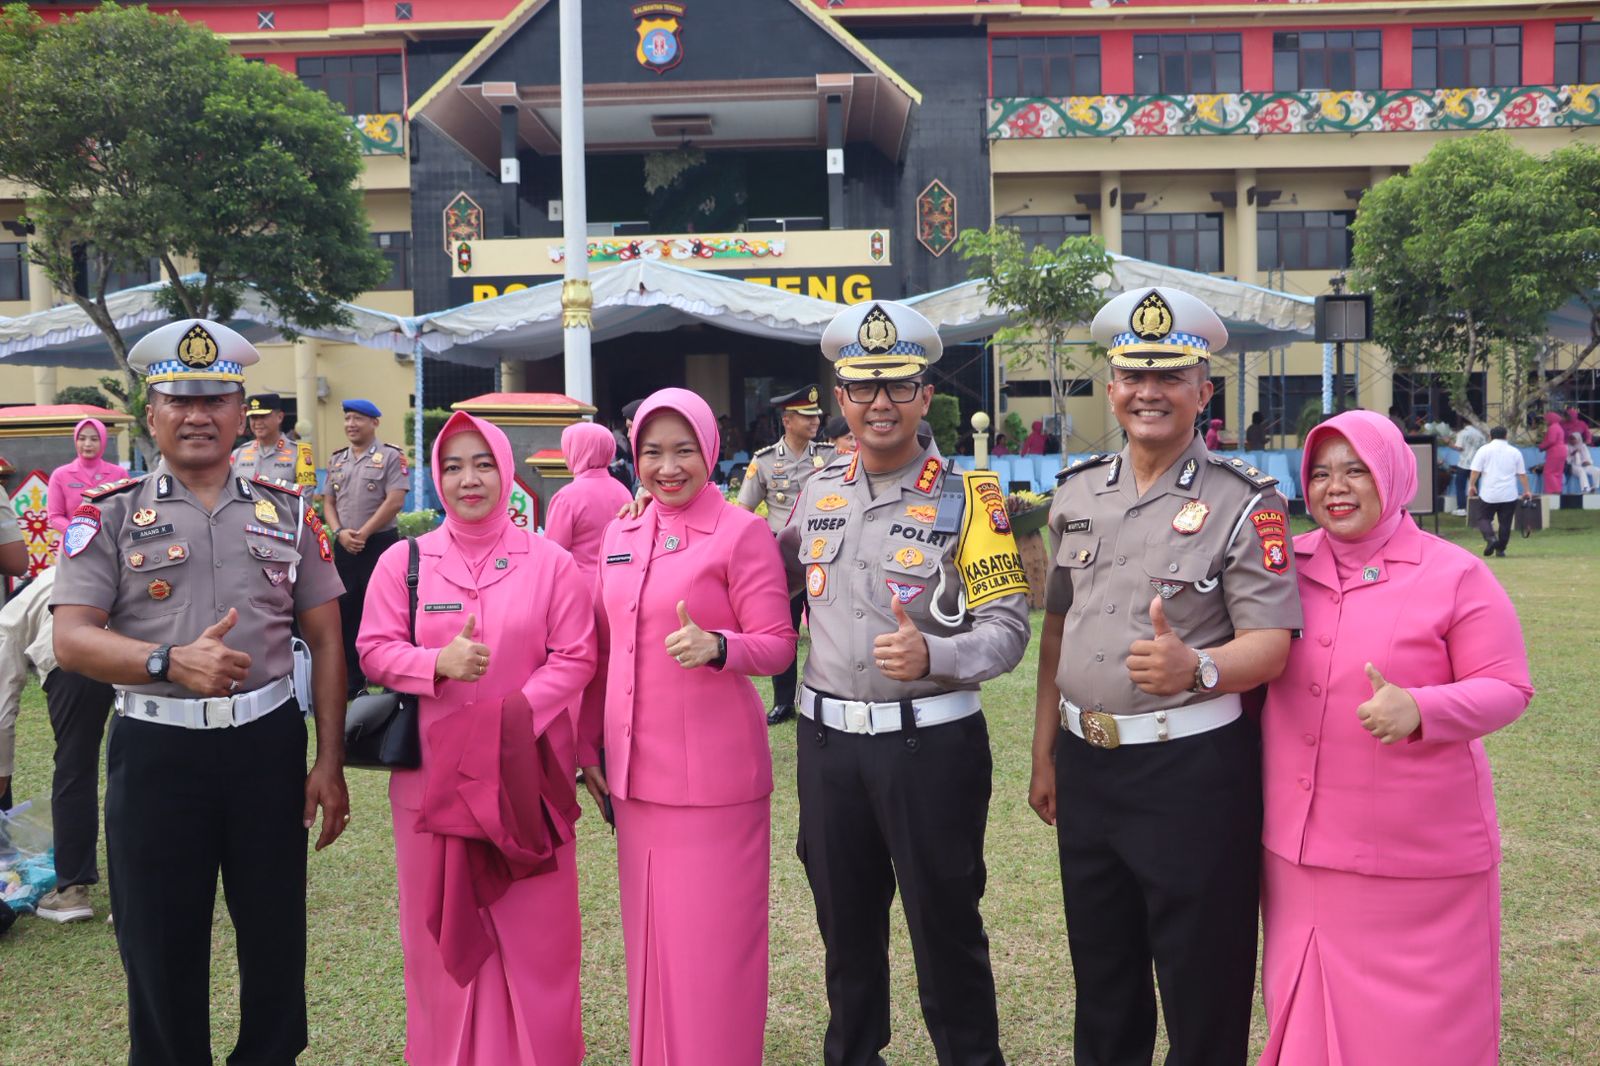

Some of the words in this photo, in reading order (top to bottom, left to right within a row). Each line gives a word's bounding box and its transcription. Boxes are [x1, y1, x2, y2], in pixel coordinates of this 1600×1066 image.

[1254, 513, 1282, 523] POLDA
[140, 528, 160, 538] ANANG
[807, 517, 846, 531] YUSEP
[889, 523, 947, 548] POLRI
[973, 581, 988, 596] OPS
[988, 575, 1010, 588] LILIN
